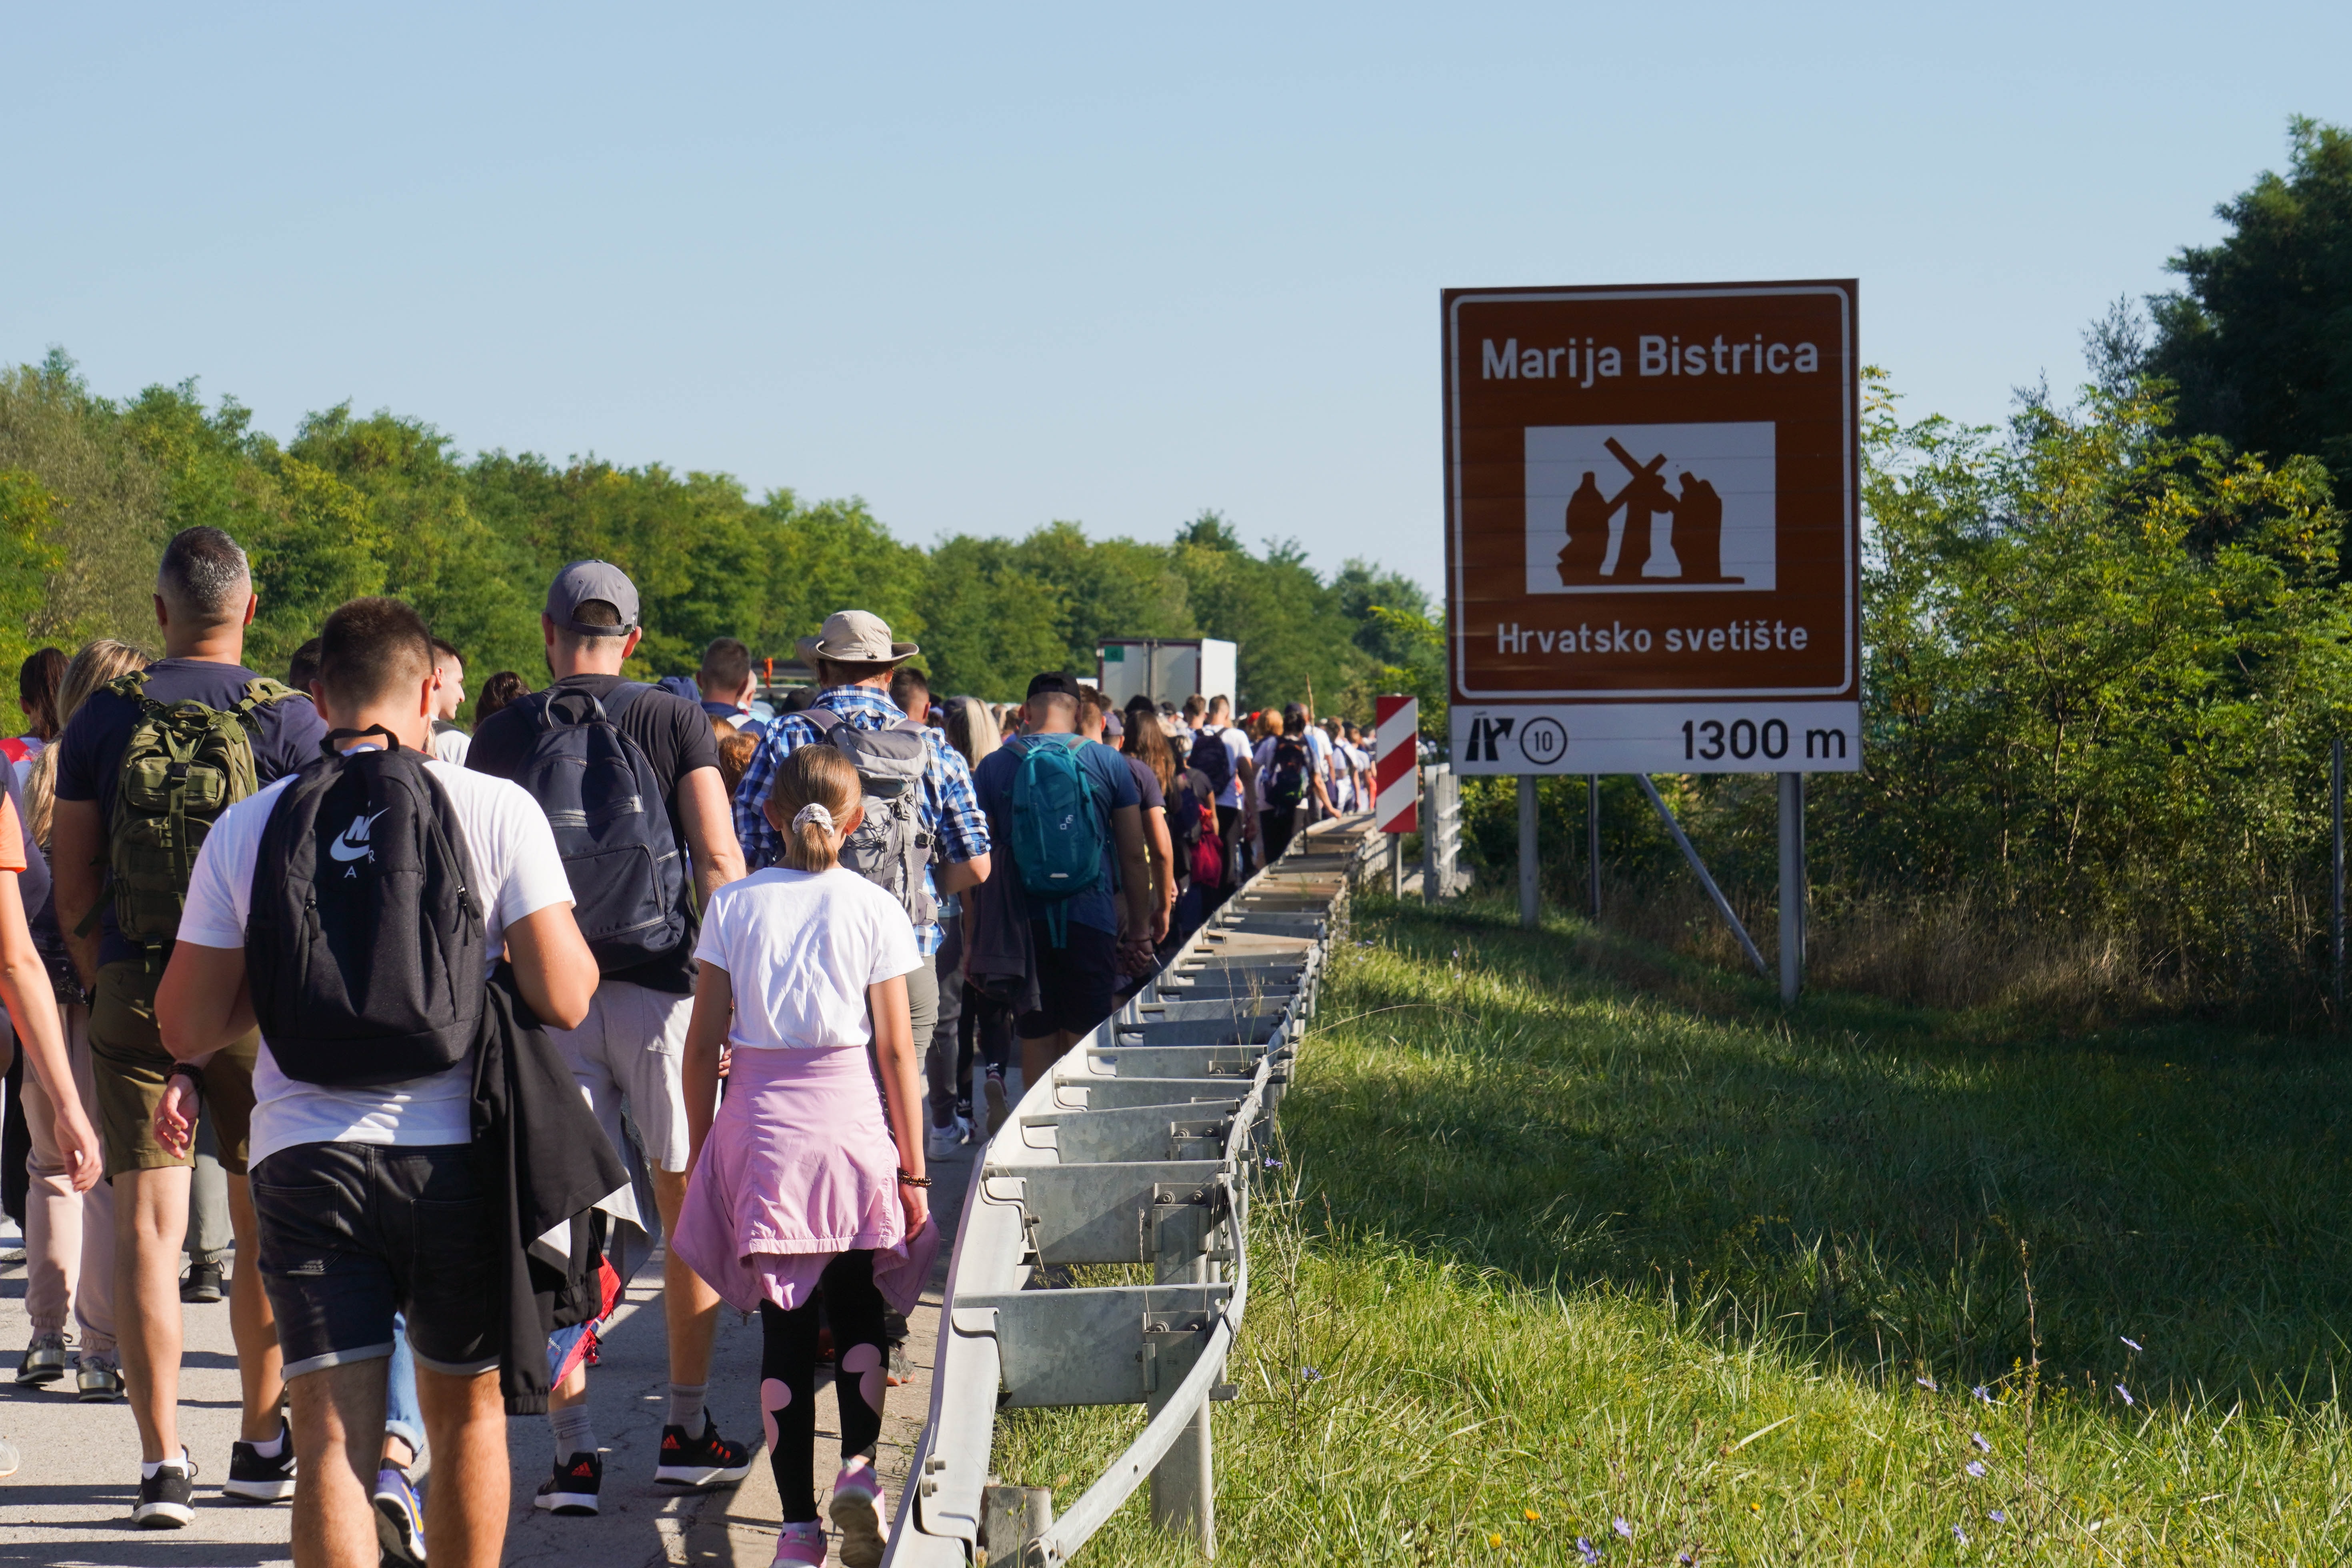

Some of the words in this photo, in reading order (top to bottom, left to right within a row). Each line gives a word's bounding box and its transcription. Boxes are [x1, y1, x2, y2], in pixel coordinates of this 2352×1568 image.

[1482, 337, 1621, 389] Marija
[1639, 334, 1818, 377] Bistrica
[1497, 620, 1652, 654] Hrvatsko
[1665, 620, 1808, 652] svetište
[1534, 730, 1554, 753] 10
[1682, 718, 1789, 761] 1300
[1806, 728, 1846, 759] m
